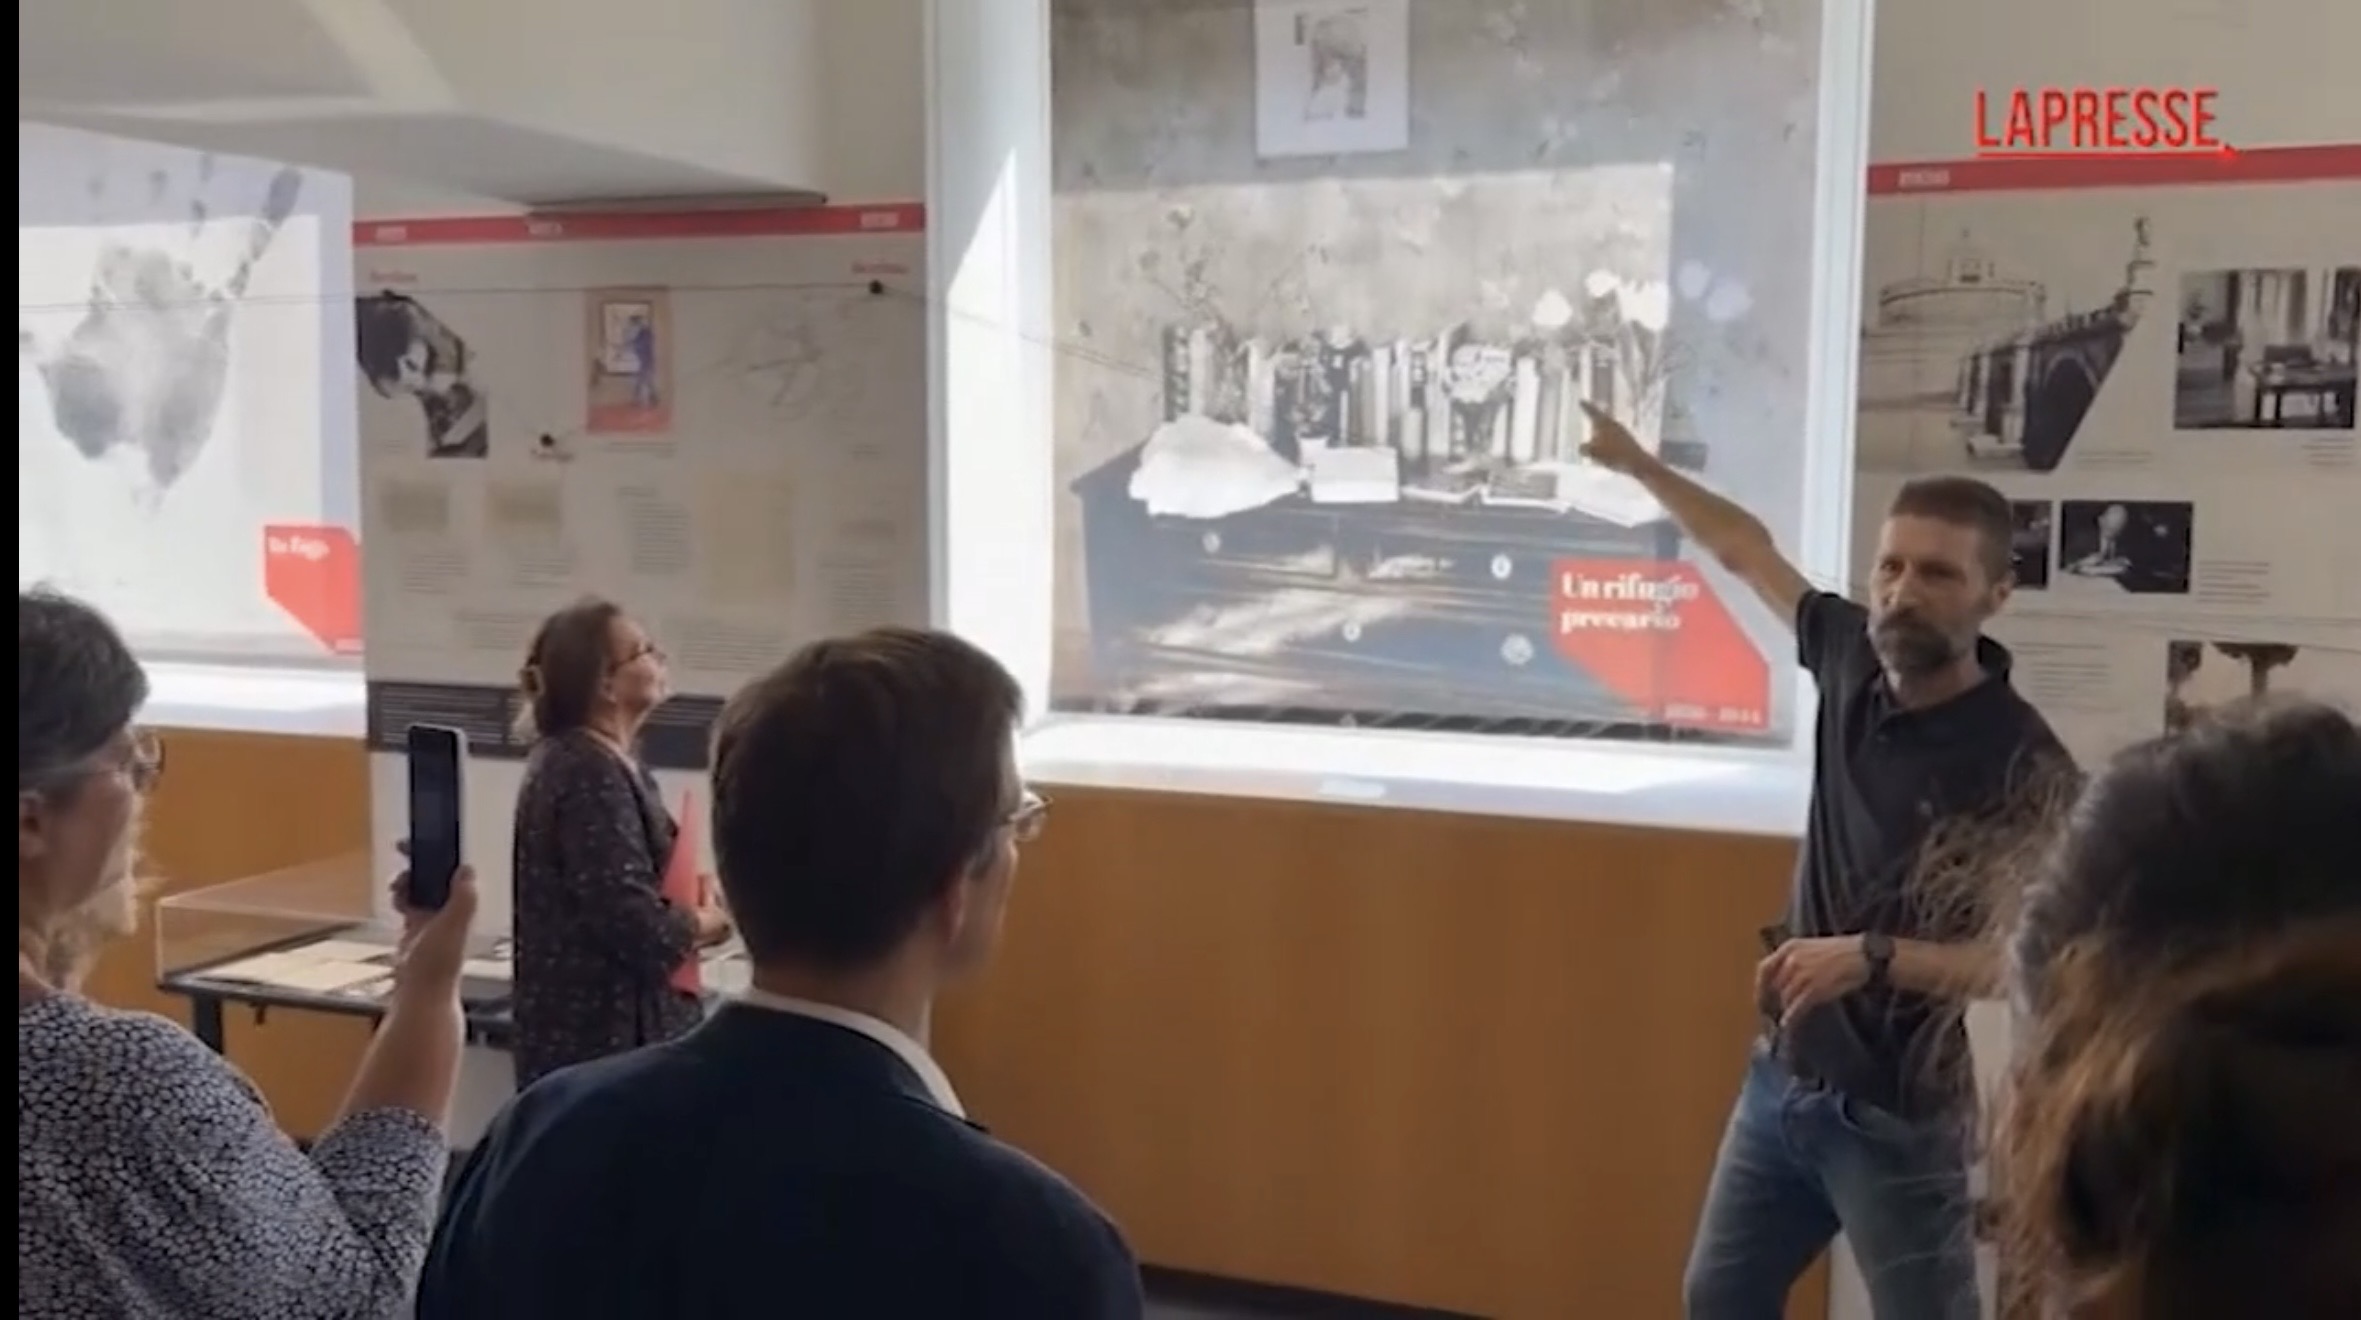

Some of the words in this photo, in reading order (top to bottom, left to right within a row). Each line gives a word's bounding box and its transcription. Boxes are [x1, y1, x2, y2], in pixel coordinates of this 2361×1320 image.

[1562, 571, 1600, 600] Un
[1603, 571, 1700, 607] rifugio
[1560, 608, 1682, 635] precario
